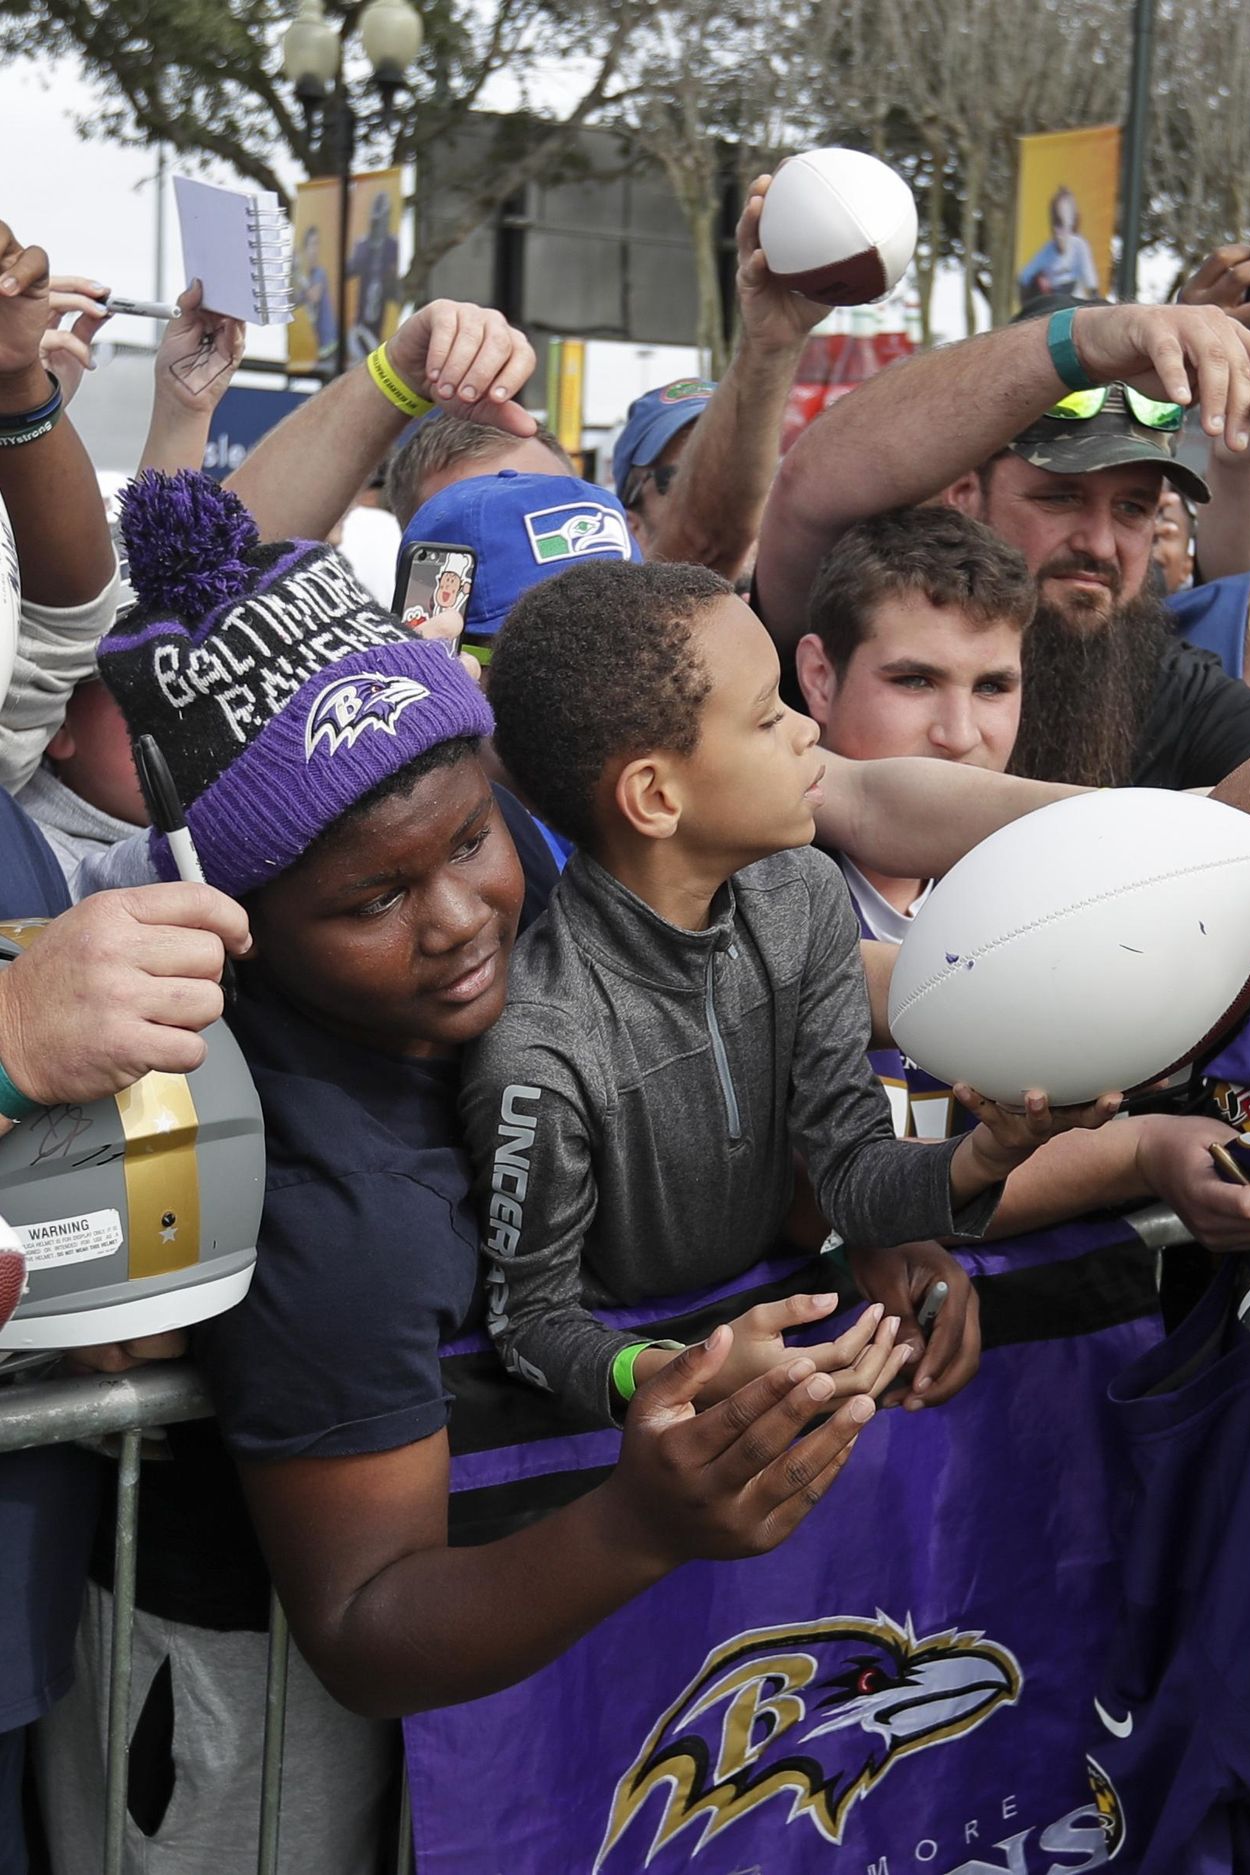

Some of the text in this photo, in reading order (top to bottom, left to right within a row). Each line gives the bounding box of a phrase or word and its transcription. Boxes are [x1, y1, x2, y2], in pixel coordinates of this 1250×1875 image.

[154, 553, 371, 710] BALTIMOR
[28, 1219, 90, 1240] WARNING
[488, 1084, 542, 1257] UNDER
